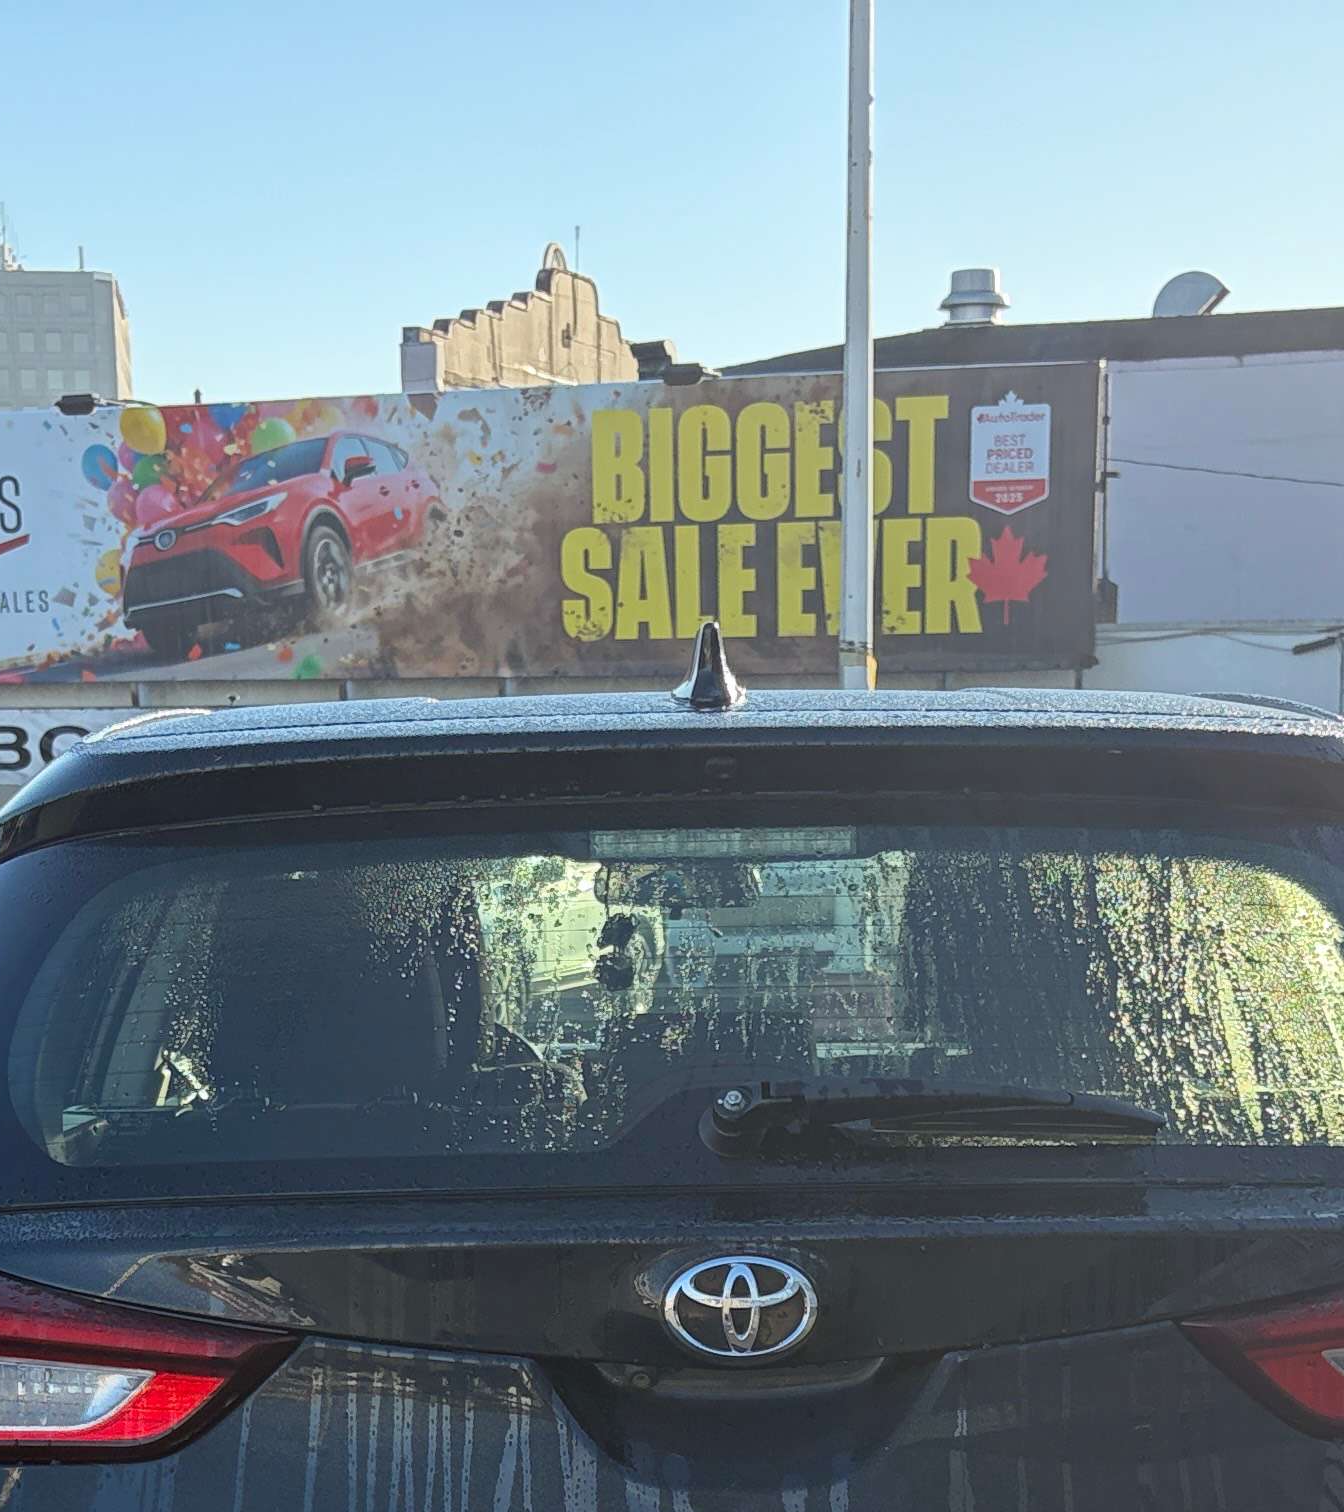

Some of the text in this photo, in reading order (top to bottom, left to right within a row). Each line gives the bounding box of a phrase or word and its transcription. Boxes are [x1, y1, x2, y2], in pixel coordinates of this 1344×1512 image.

[993, 433, 1027, 447] BEST
[986, 447, 1034, 460] PRICED
[985, 461, 1035, 474] DEALER
[561, 524, 757, 642] SALE
